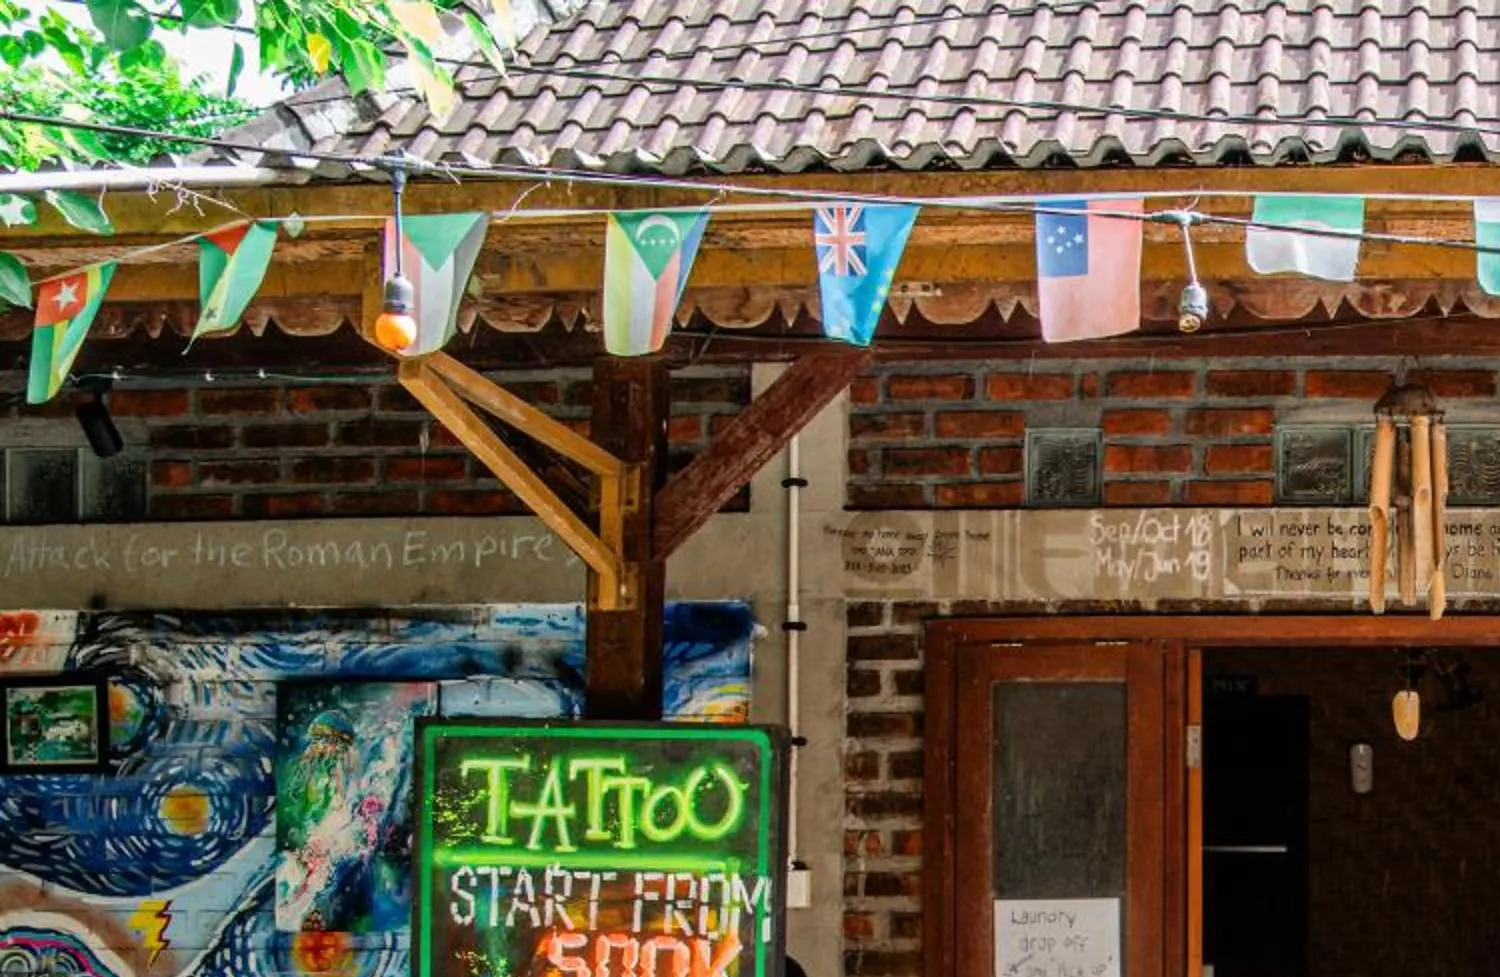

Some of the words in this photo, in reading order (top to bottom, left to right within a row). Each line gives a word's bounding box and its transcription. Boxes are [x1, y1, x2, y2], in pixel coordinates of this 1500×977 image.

[1280, 523, 1320, 537] never
[1327, 516, 1343, 536] be
[189, 528, 250, 568] the
[263, 528, 392, 570] Roman
[1300, 546, 1325, 566] my
[450, 862, 617, 931] START
[632, 868, 772, 943] FROM
[1010, 910, 1077, 929] Laundry
